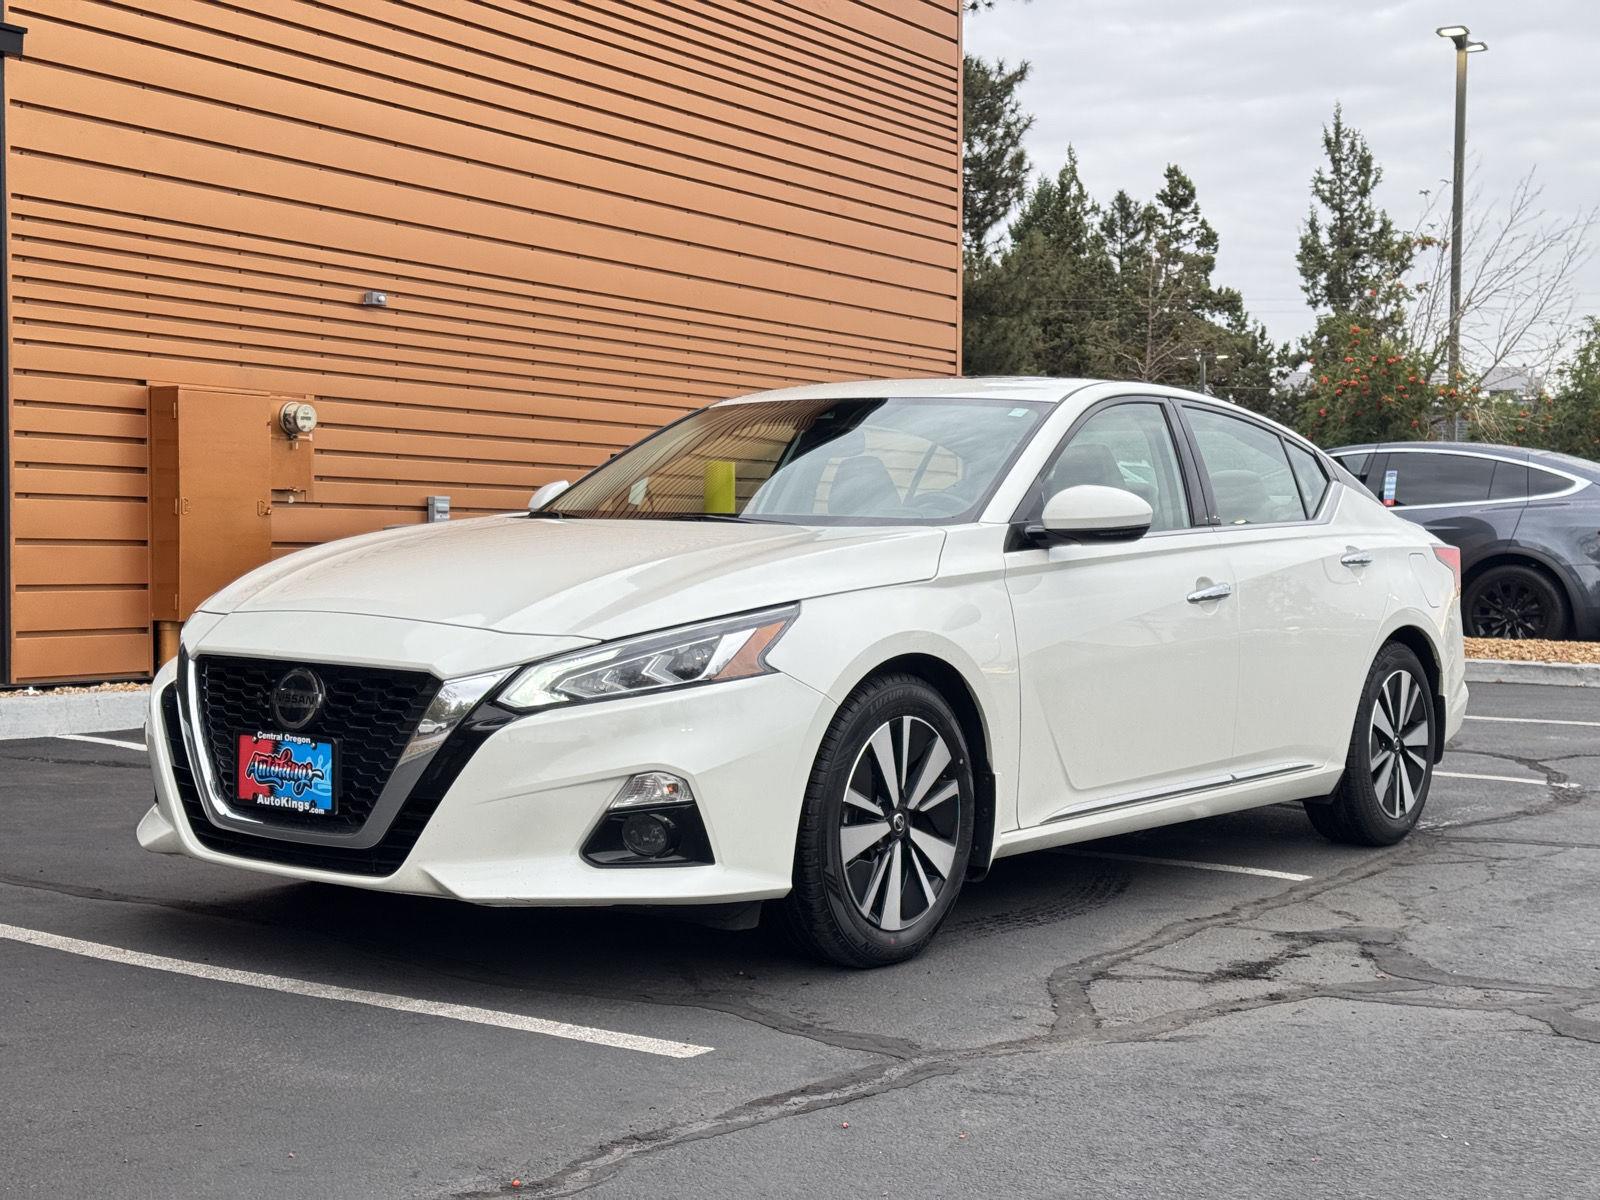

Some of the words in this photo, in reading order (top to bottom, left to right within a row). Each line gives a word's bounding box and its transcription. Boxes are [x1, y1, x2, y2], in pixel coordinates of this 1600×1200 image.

[276, 692, 313, 705] NISSAN
[257, 731, 283, 741] Central
[284, 734, 311, 744] Oregon
